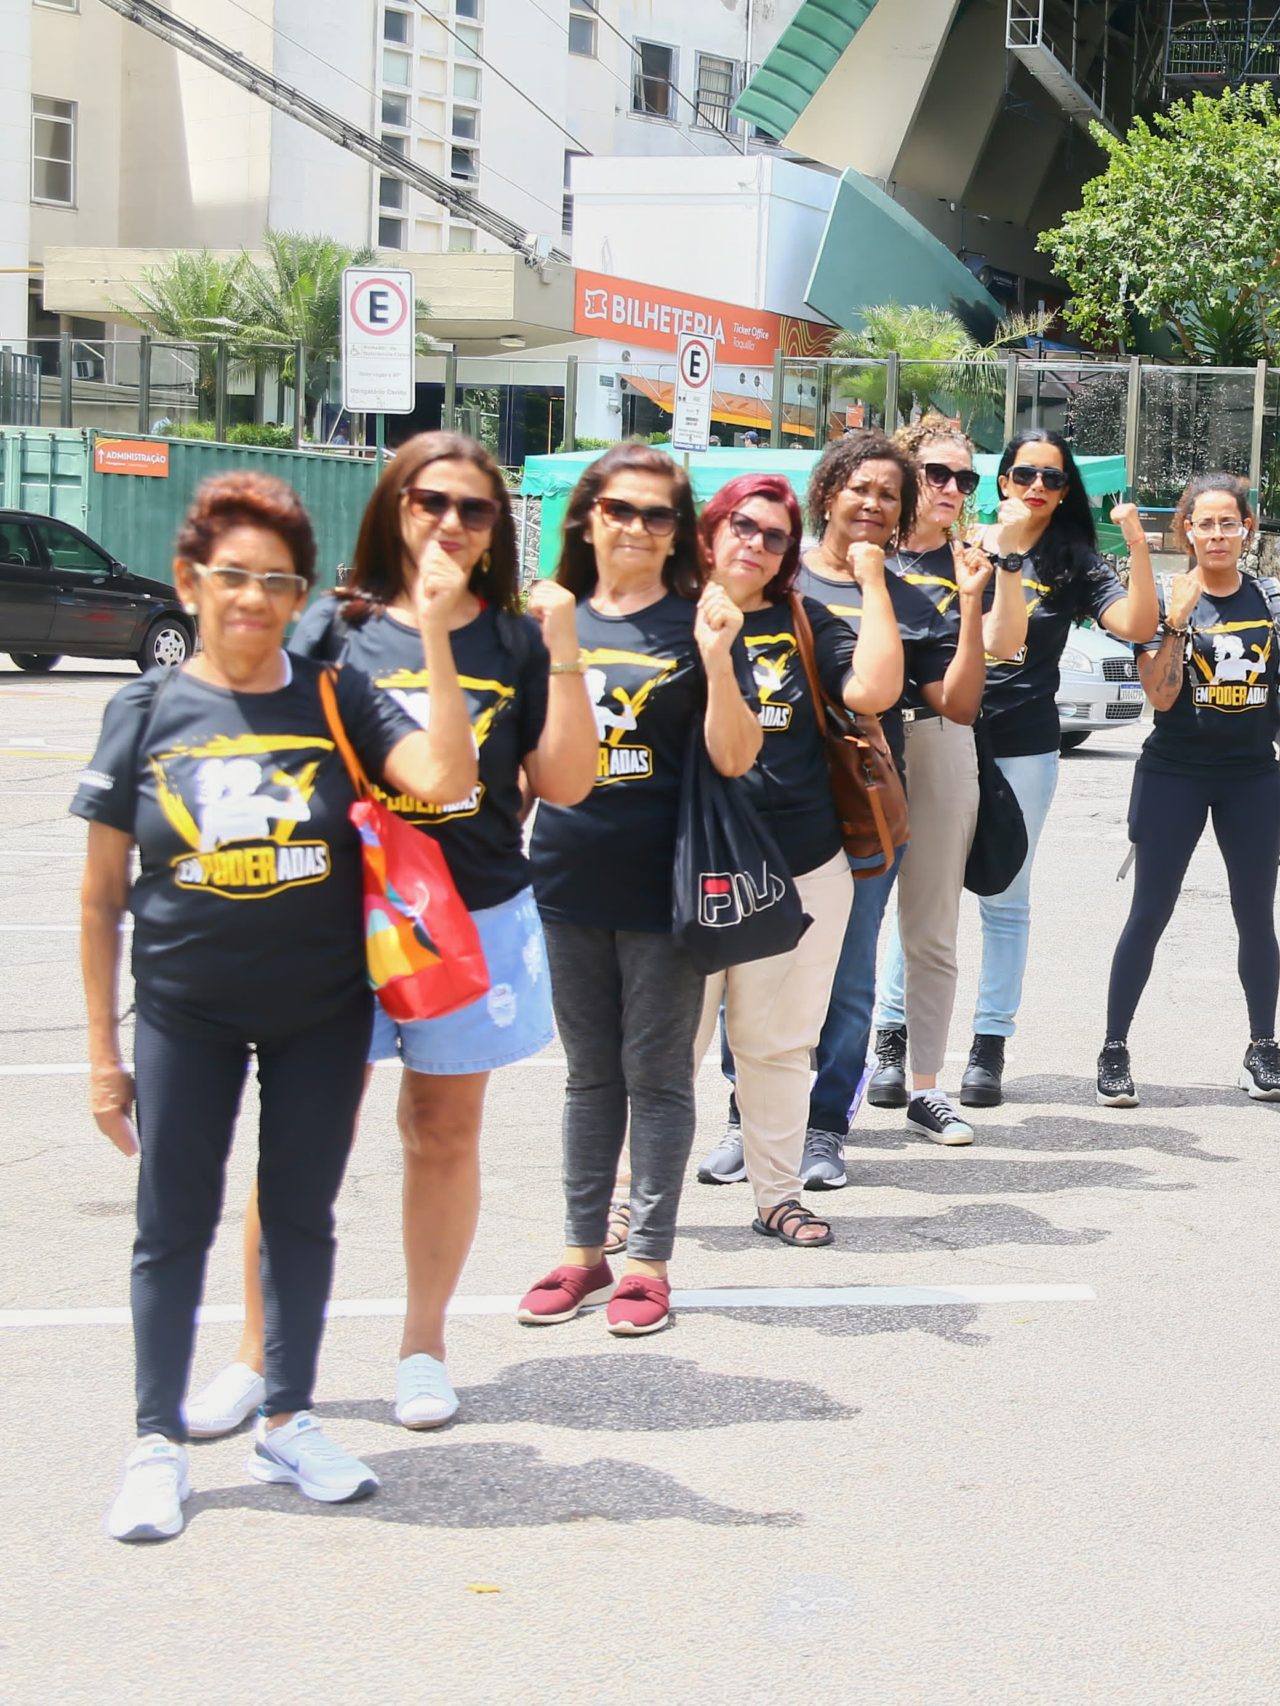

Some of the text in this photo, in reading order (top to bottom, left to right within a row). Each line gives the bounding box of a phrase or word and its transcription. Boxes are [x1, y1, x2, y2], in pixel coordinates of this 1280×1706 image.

[369, 290, 389, 323] E
[611, 294, 726, 345] BILHETERIA
[733, 322, 769, 340] Ticket Office
[689, 350, 701, 378] E
[106, 451, 167, 465] ADMINISTRAÇÃO
[178, 846, 327, 887] EMPODERADAS
